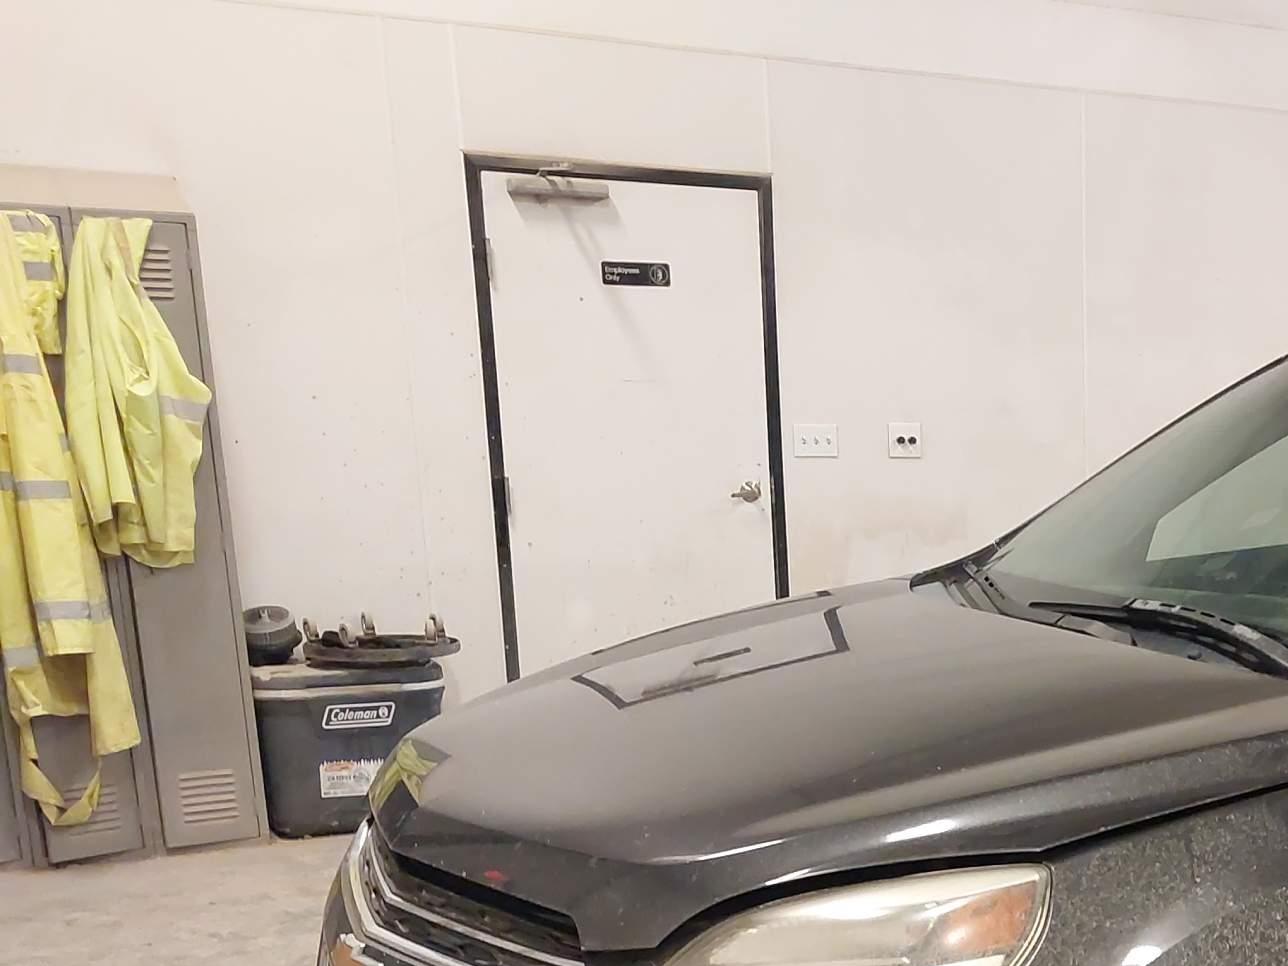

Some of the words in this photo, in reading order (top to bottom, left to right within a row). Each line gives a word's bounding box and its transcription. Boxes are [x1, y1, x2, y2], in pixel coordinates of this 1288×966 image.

[604, 265, 640, 275] Employees
[605, 273, 621, 282] Only
[330, 708, 377, 722] Coleman
